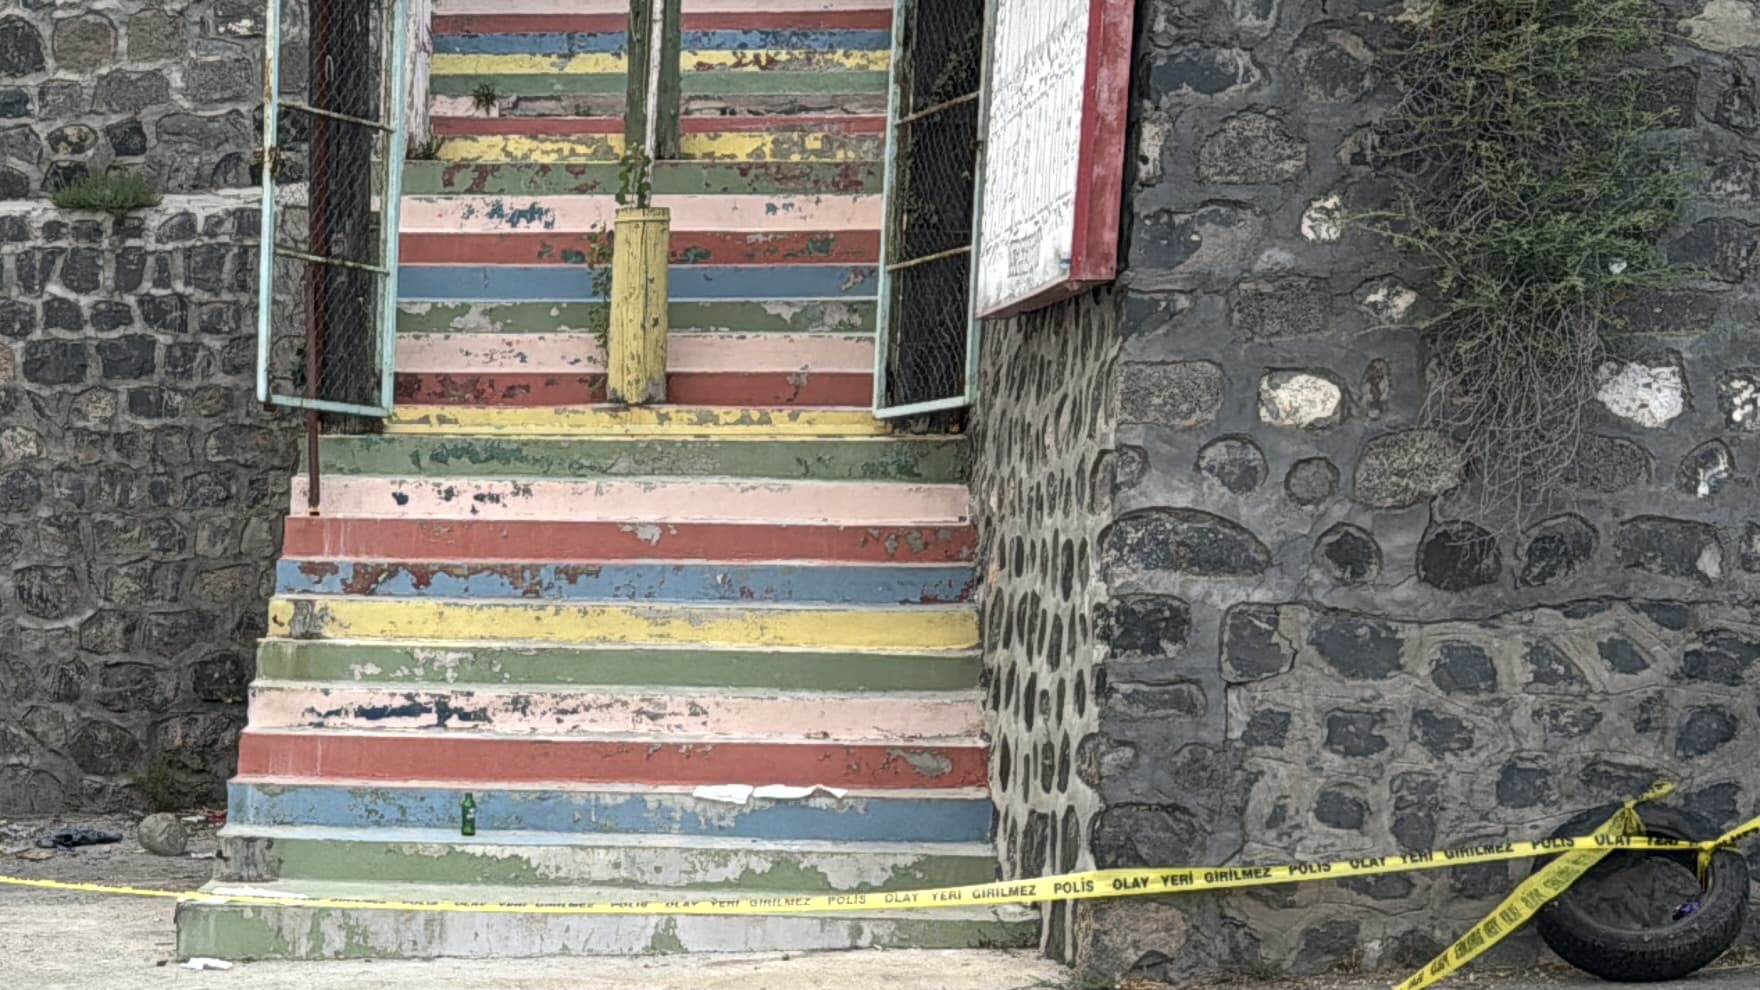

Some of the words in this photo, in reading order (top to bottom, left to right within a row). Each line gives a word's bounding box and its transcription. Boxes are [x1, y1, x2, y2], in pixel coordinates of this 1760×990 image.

[1053, 876, 1095, 895] POLİS
[1112, 877, 1150, 891] OLAY
[1160, 871, 1194, 887] YERİ
